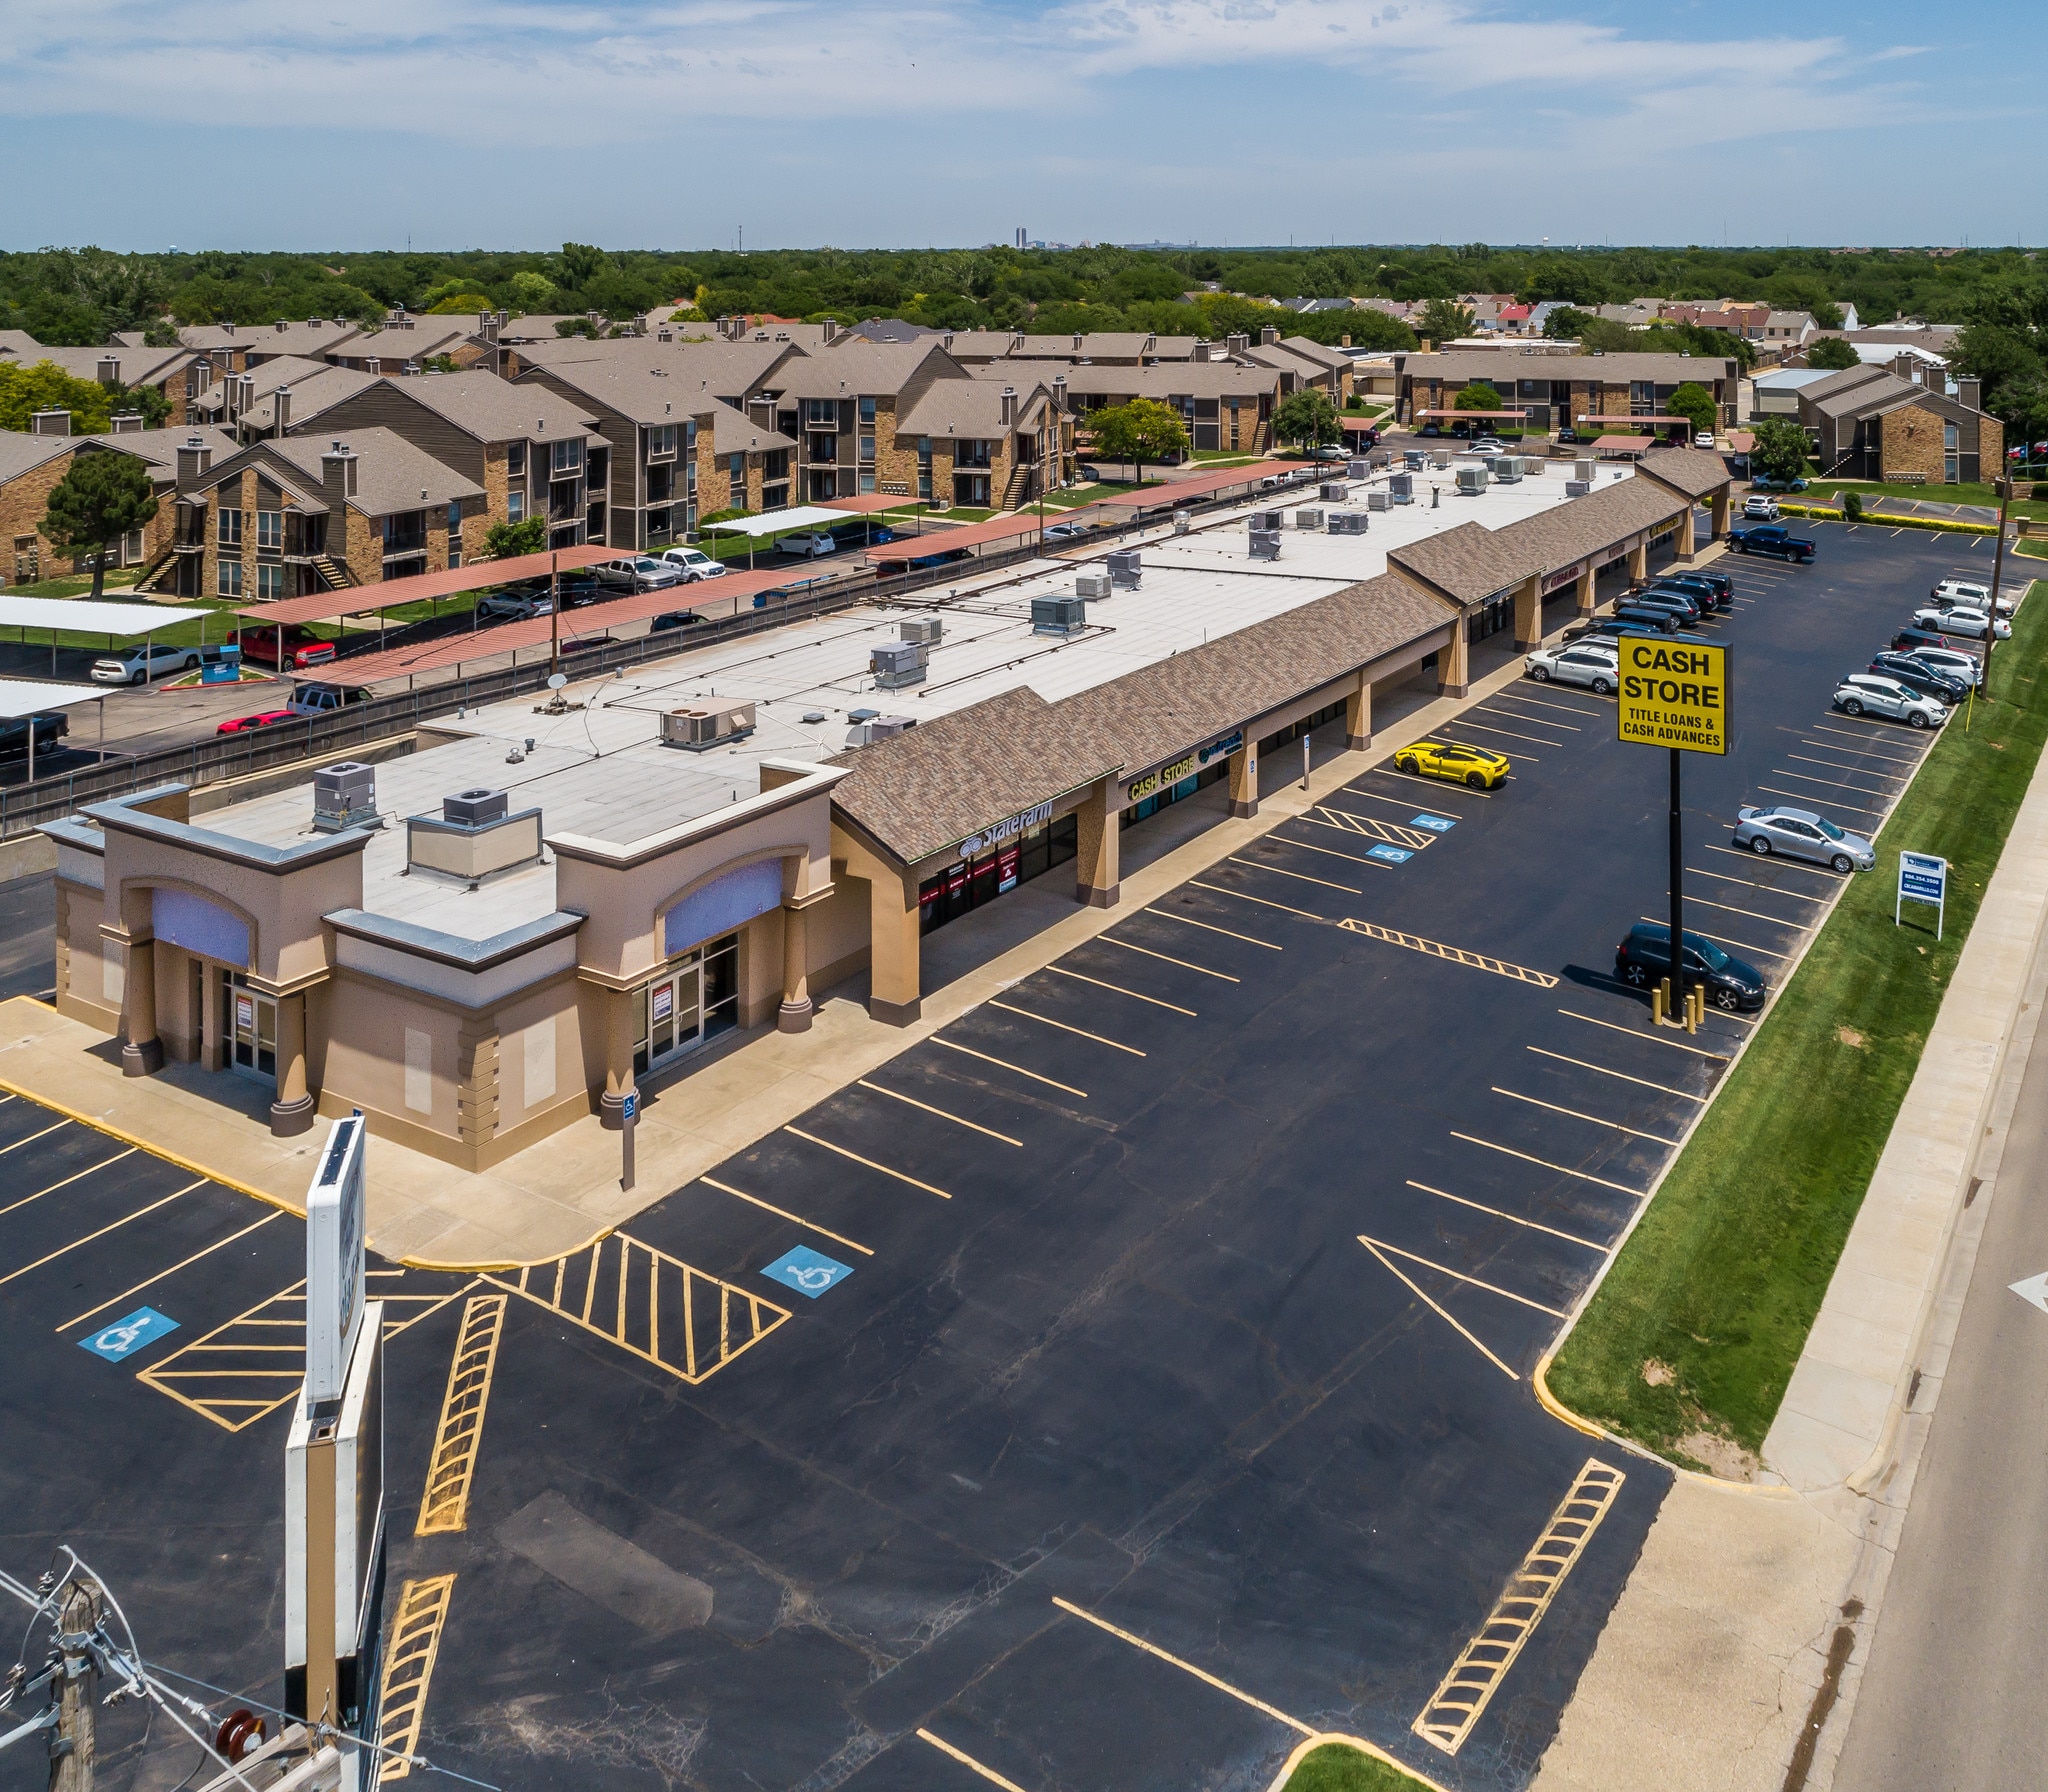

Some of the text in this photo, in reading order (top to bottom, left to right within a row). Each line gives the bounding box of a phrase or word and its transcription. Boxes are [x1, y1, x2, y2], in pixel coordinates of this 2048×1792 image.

[1632, 646, 1710, 676] CASH
[1624, 675, 1720, 709] STORE
[1628, 707, 1714, 730] TITLE LOANS &
[1623, 722, 1720, 747] CASH ADVANCES
[1130, 755, 1195, 801] CASH STORE
